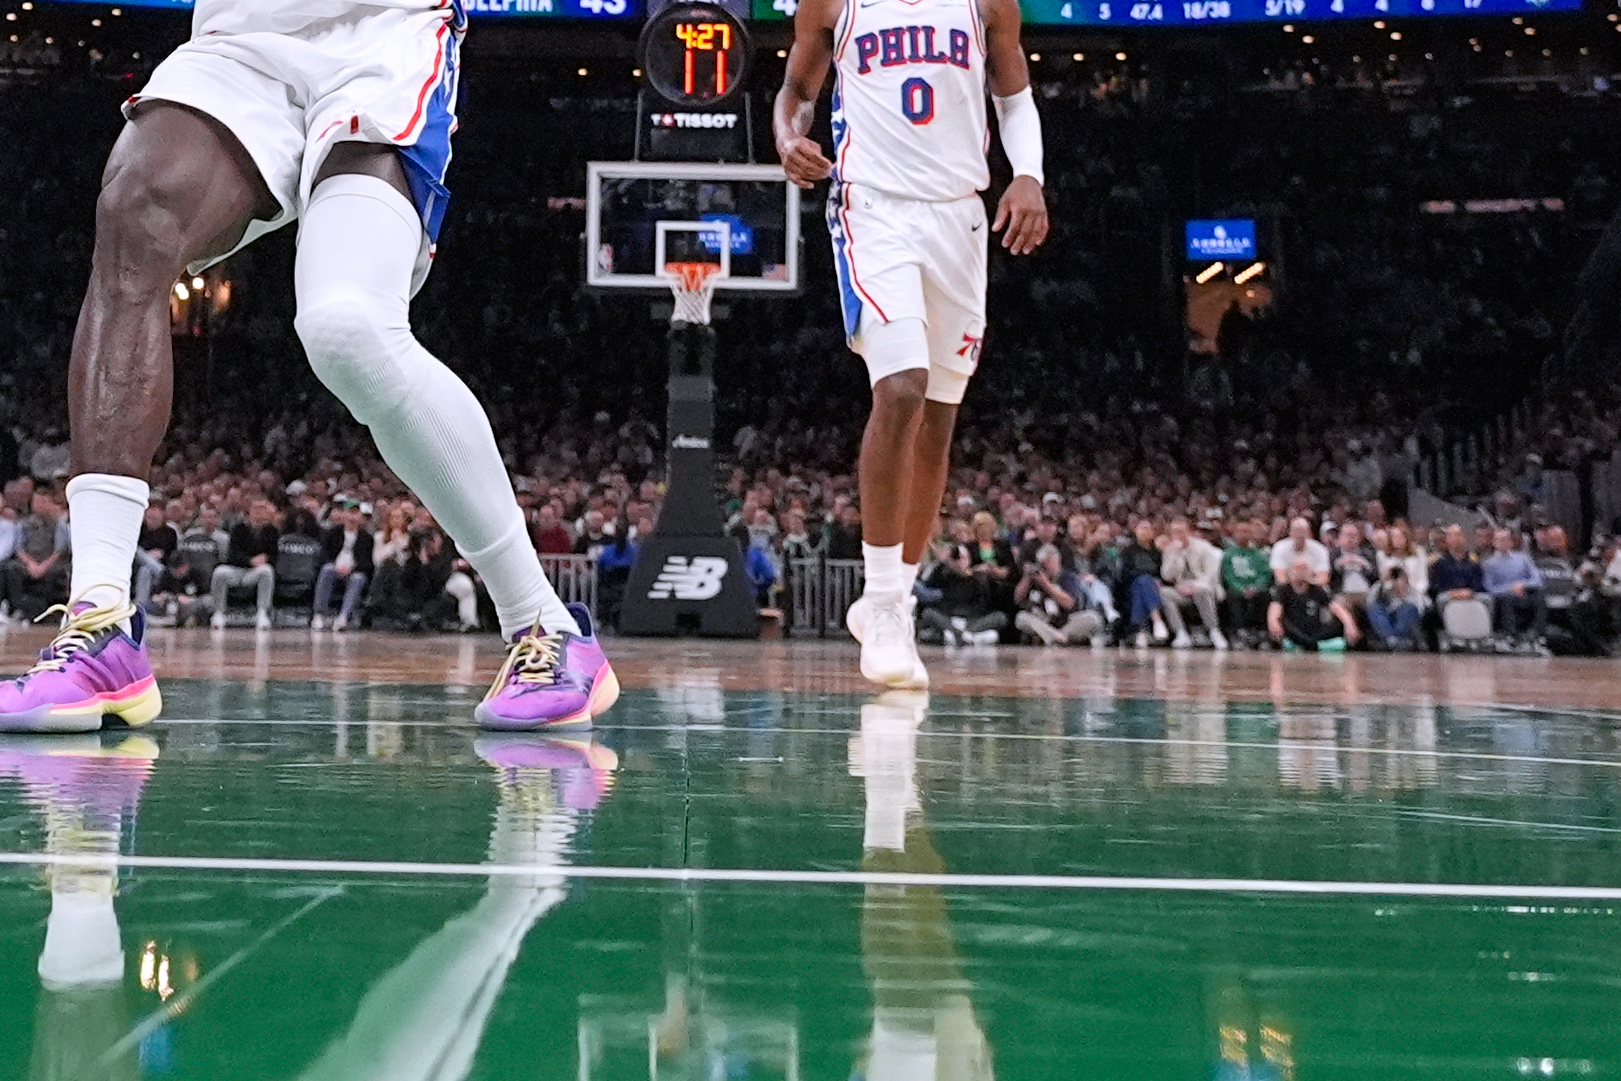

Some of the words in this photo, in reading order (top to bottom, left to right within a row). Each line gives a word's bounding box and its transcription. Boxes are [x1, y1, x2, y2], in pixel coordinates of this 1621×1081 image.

[676, 23, 731, 51] 4:27
[854, 25, 970, 75] PHILA
[685, 50, 727, 95] 11
[901, 77, 934, 125] 0
